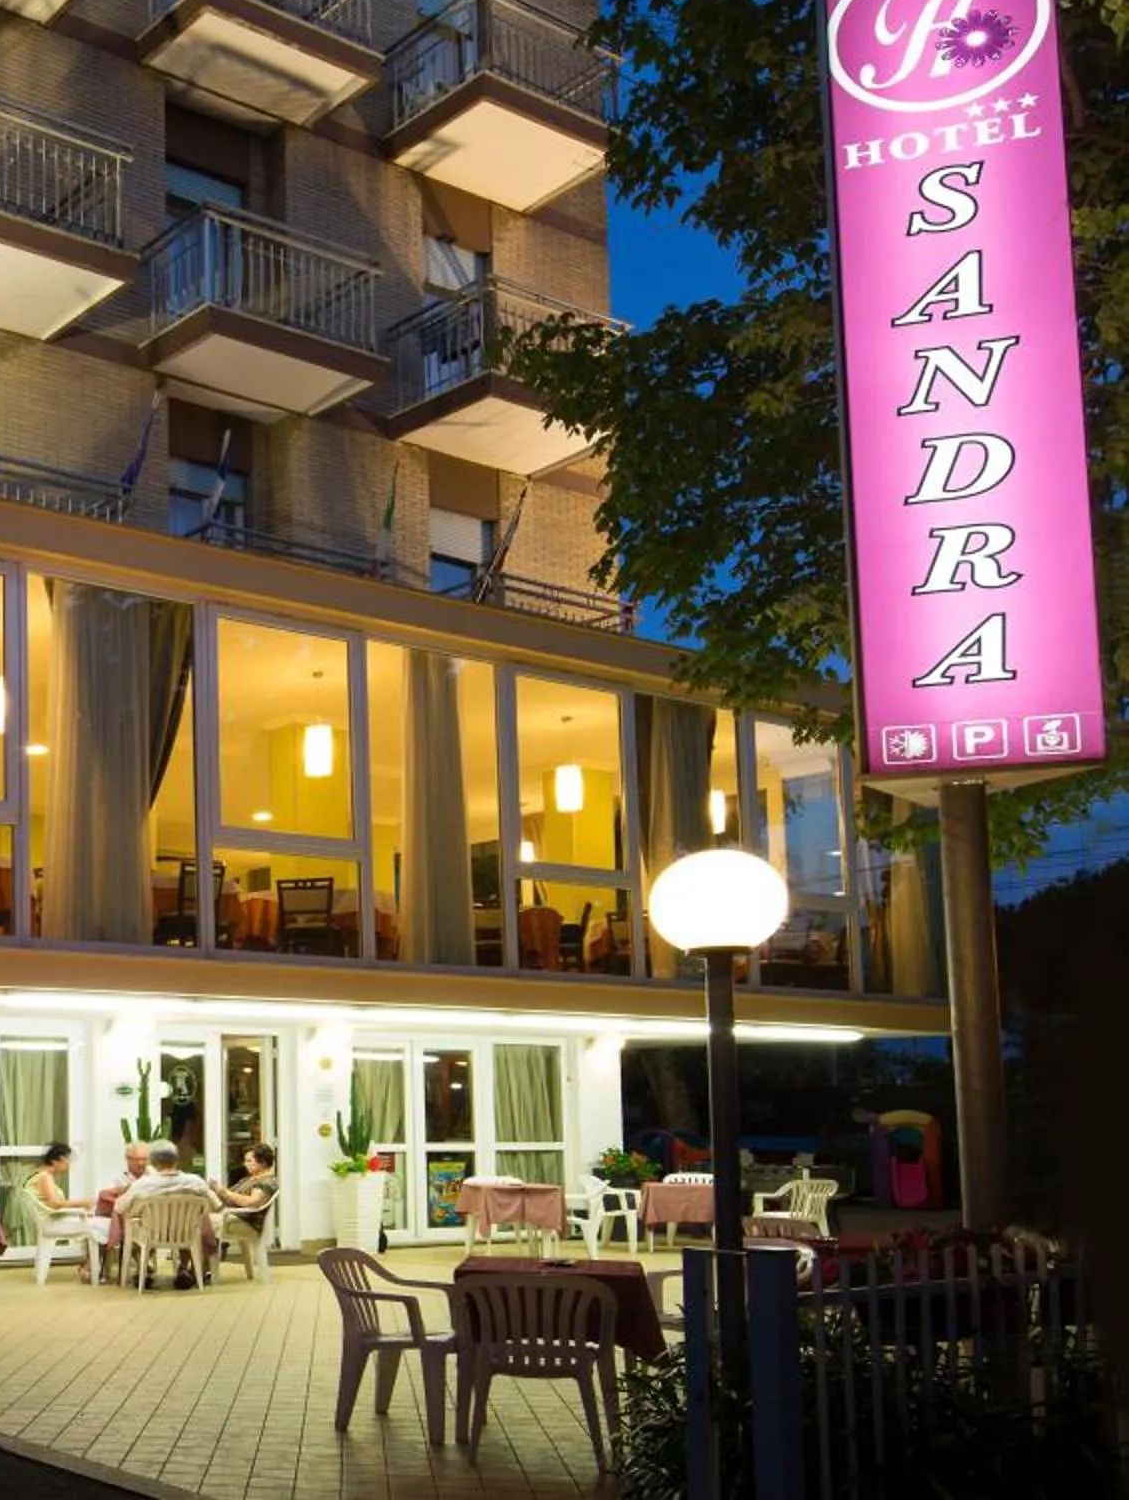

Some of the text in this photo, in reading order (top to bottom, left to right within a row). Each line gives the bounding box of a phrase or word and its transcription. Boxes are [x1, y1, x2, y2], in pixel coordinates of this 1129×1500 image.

[843, 111, 1042, 170] HOTEL
[891, 160, 1023, 689] SANDRA
[964, 725, 995, 755] P
